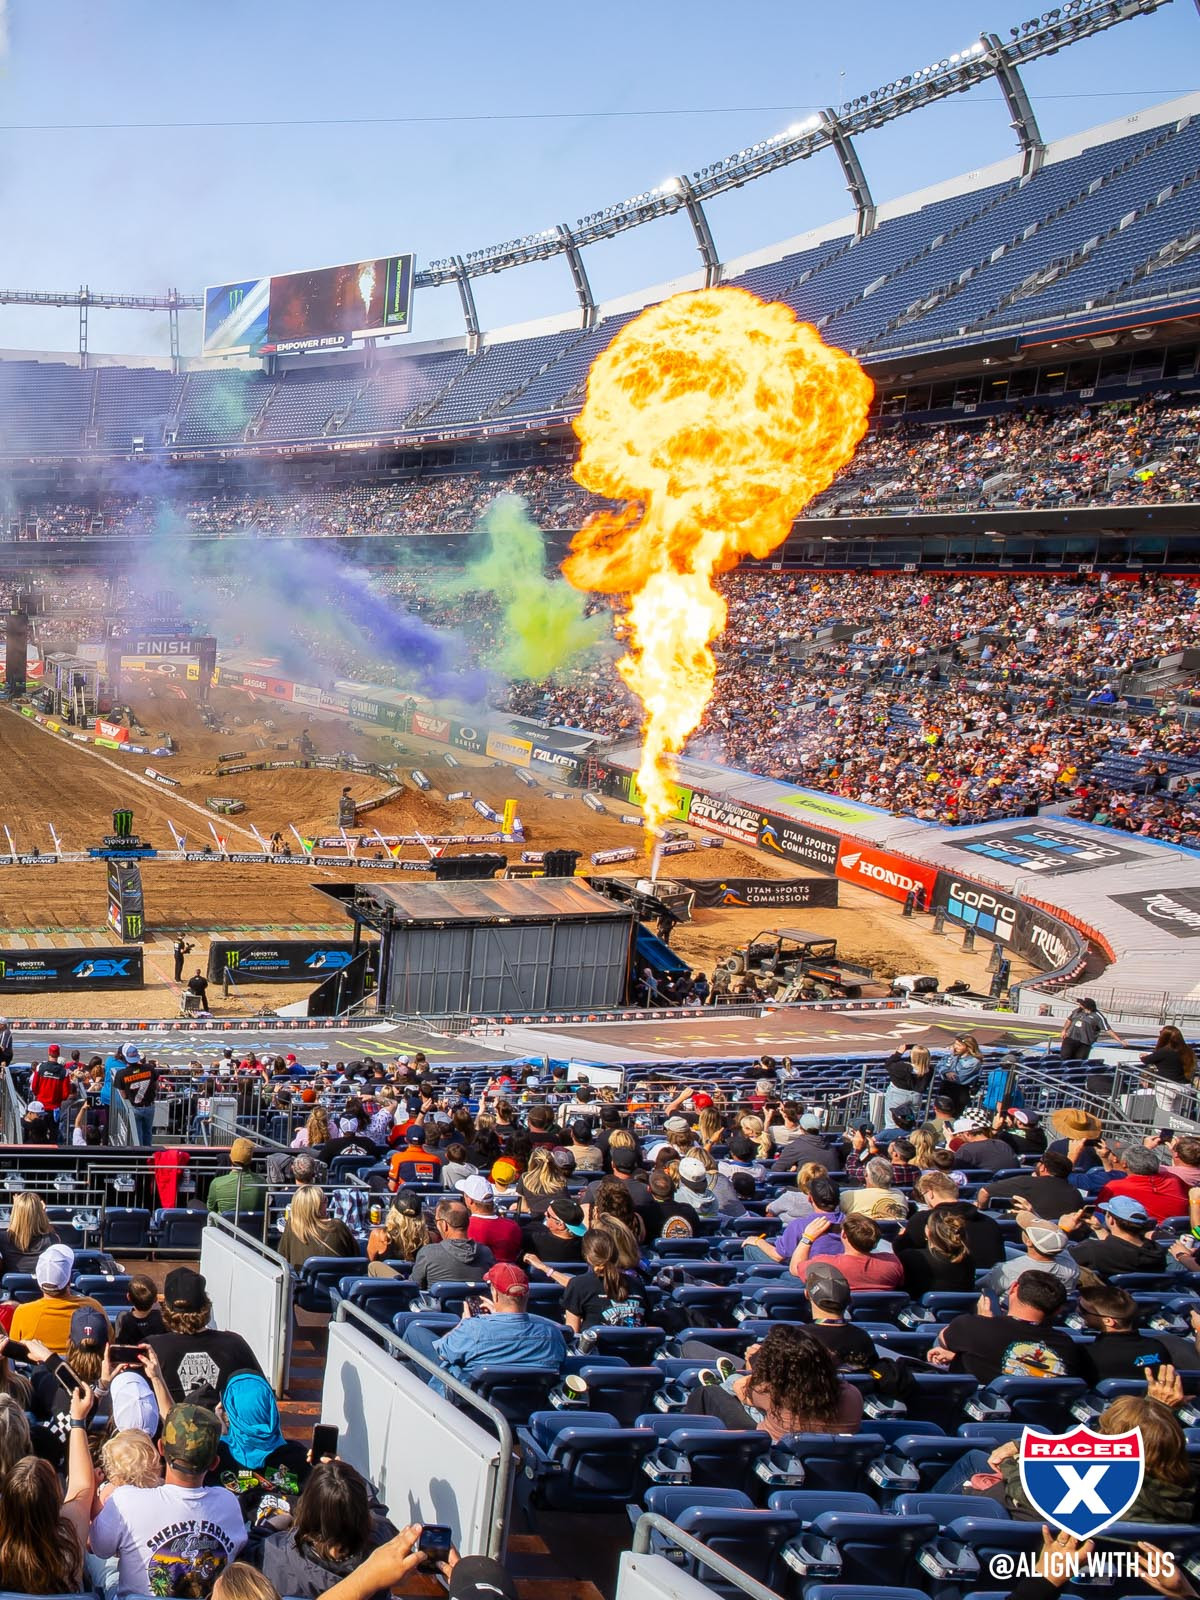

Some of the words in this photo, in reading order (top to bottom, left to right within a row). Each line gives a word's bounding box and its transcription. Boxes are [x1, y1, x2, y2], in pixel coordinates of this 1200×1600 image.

[277, 339, 319, 351] EMPOWER
[320, 336, 345, 346] FIELD
[137, 642, 191, 654] FINISH
[243, 679, 267, 689] GASGAS
[455, 737, 480, 750] OAKLEY
[533, 748, 577, 768] FALKEN
[702, 795, 721, 809] ROCKY
[723, 802, 760, 820] MOUNTAIN
[781, 840, 836, 864] COMMISSION
[783, 829, 803, 843] UTAH
[804, 836, 837, 854] SPORTS
[1033, 830, 1120, 858] GoPro
[984, 840, 1067, 866] GoPro
[859, 861, 923, 893] HONDA
[746, 894, 809, 902] COMMISSION
[747, 886, 771, 894] UTAH
[950, 882, 1016, 922] GoPro
[130, 1080, 150, 1104] 7
[821, 1092, 841, 1104] 132
[179, 1364, 216, 1375] ALIVE
[147, 1520, 196, 1552] SNEAKY
[201, 1520, 235, 1553] FARMS
